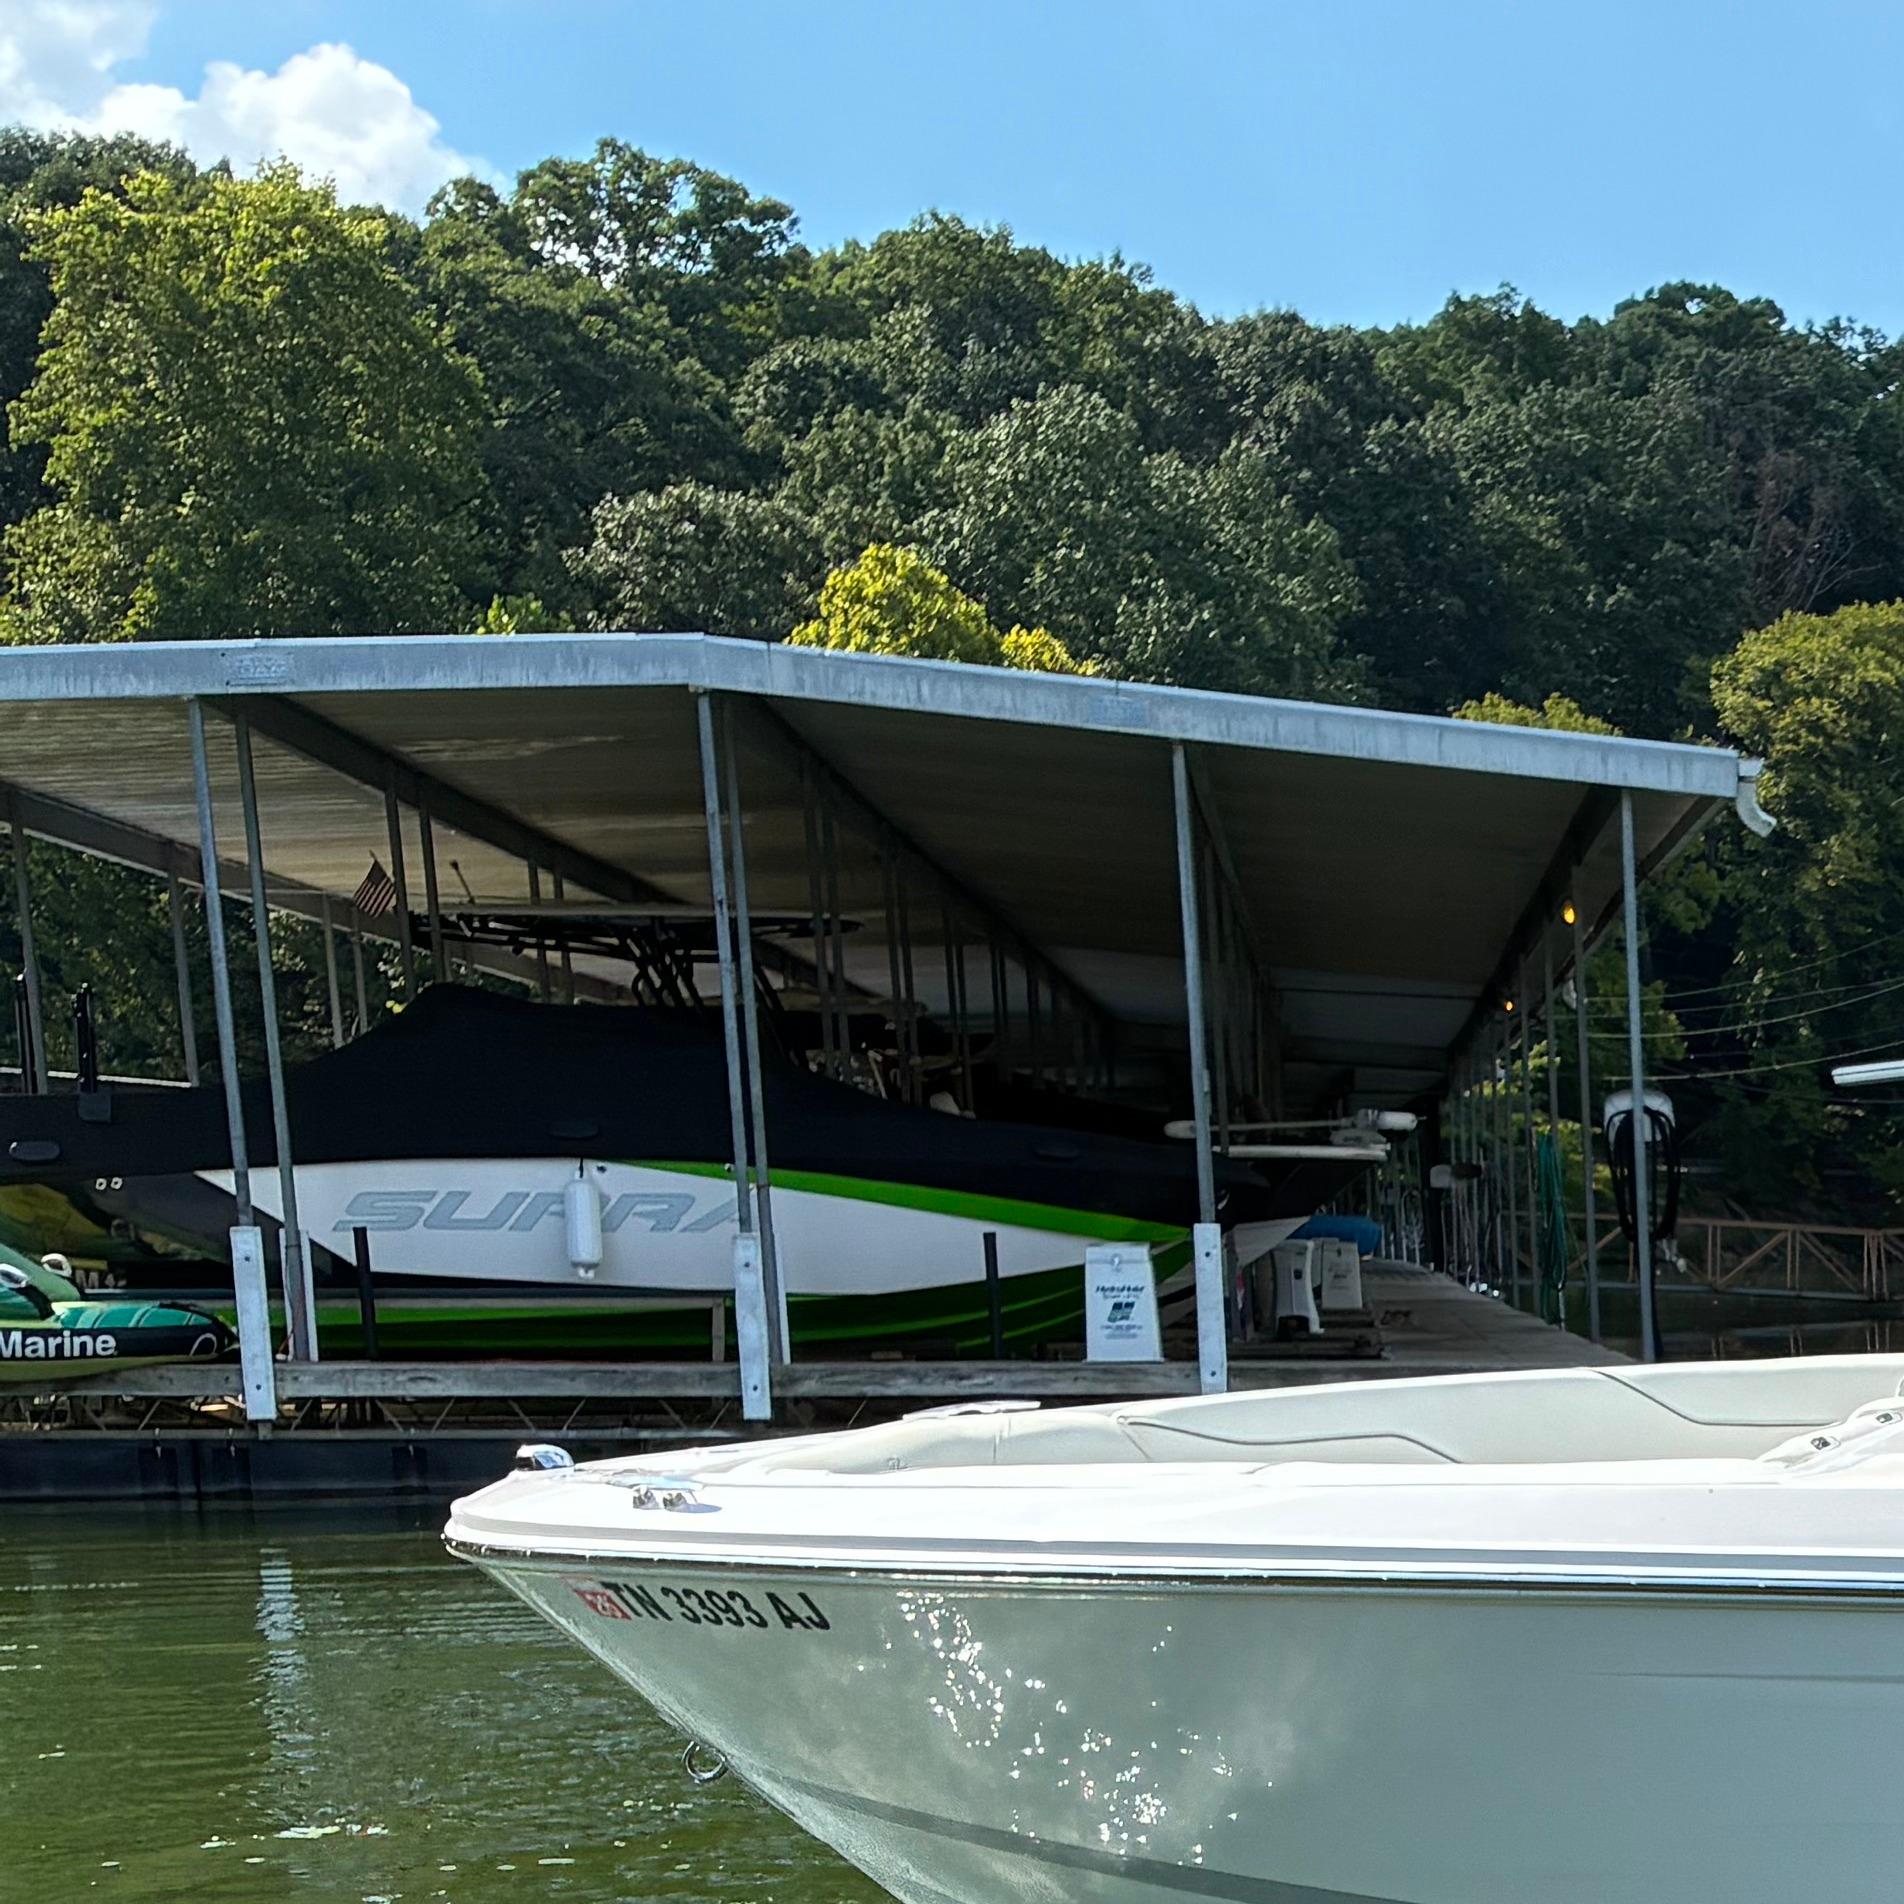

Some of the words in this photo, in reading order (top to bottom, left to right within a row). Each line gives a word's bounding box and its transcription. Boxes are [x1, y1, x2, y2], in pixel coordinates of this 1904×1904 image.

[0, 1330, 117, 1358] Marine
[601, 1580, 674, 1622] TN
[661, 1586, 769, 1629] 3393
[765, 1590, 831, 1631] AJ
